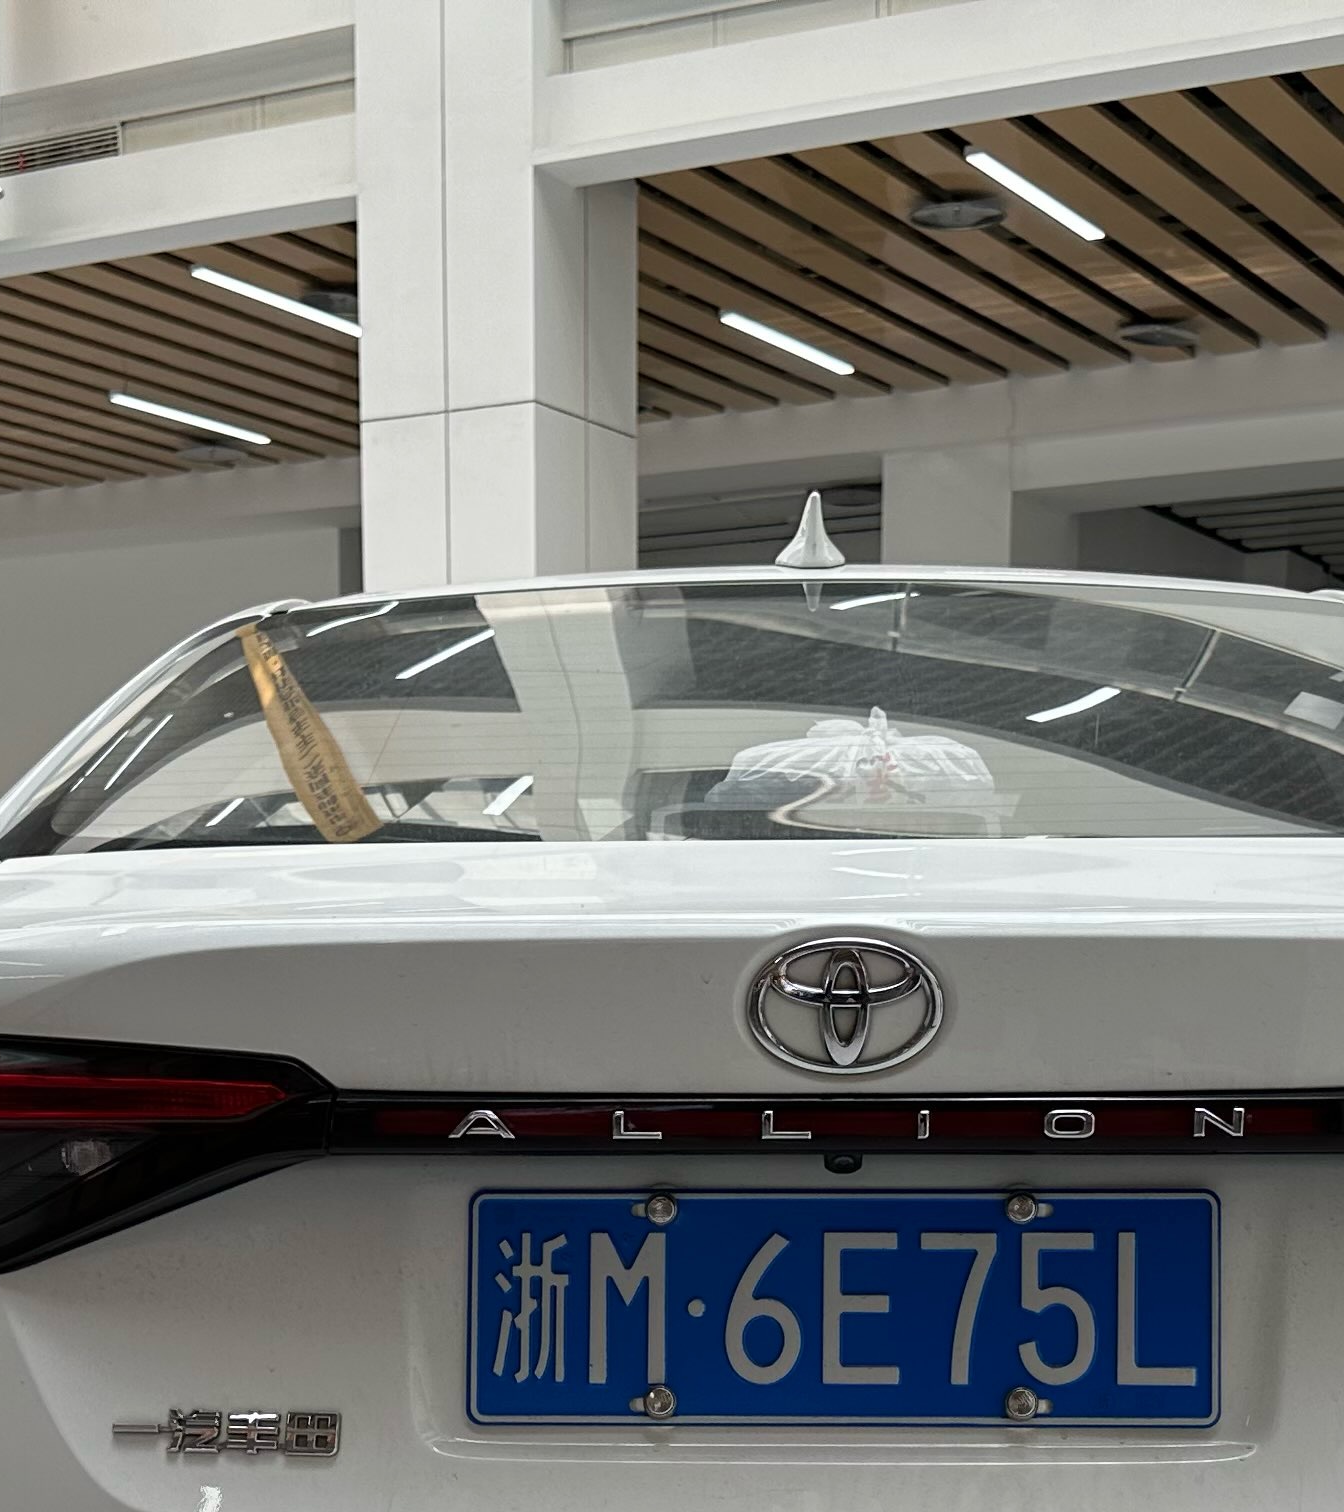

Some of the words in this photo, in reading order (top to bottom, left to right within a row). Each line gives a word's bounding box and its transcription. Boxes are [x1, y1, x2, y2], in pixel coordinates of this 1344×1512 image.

[448, 1107, 1245, 1140] ALLION
[112, 1408, 342, 1457] 一汽丰田
